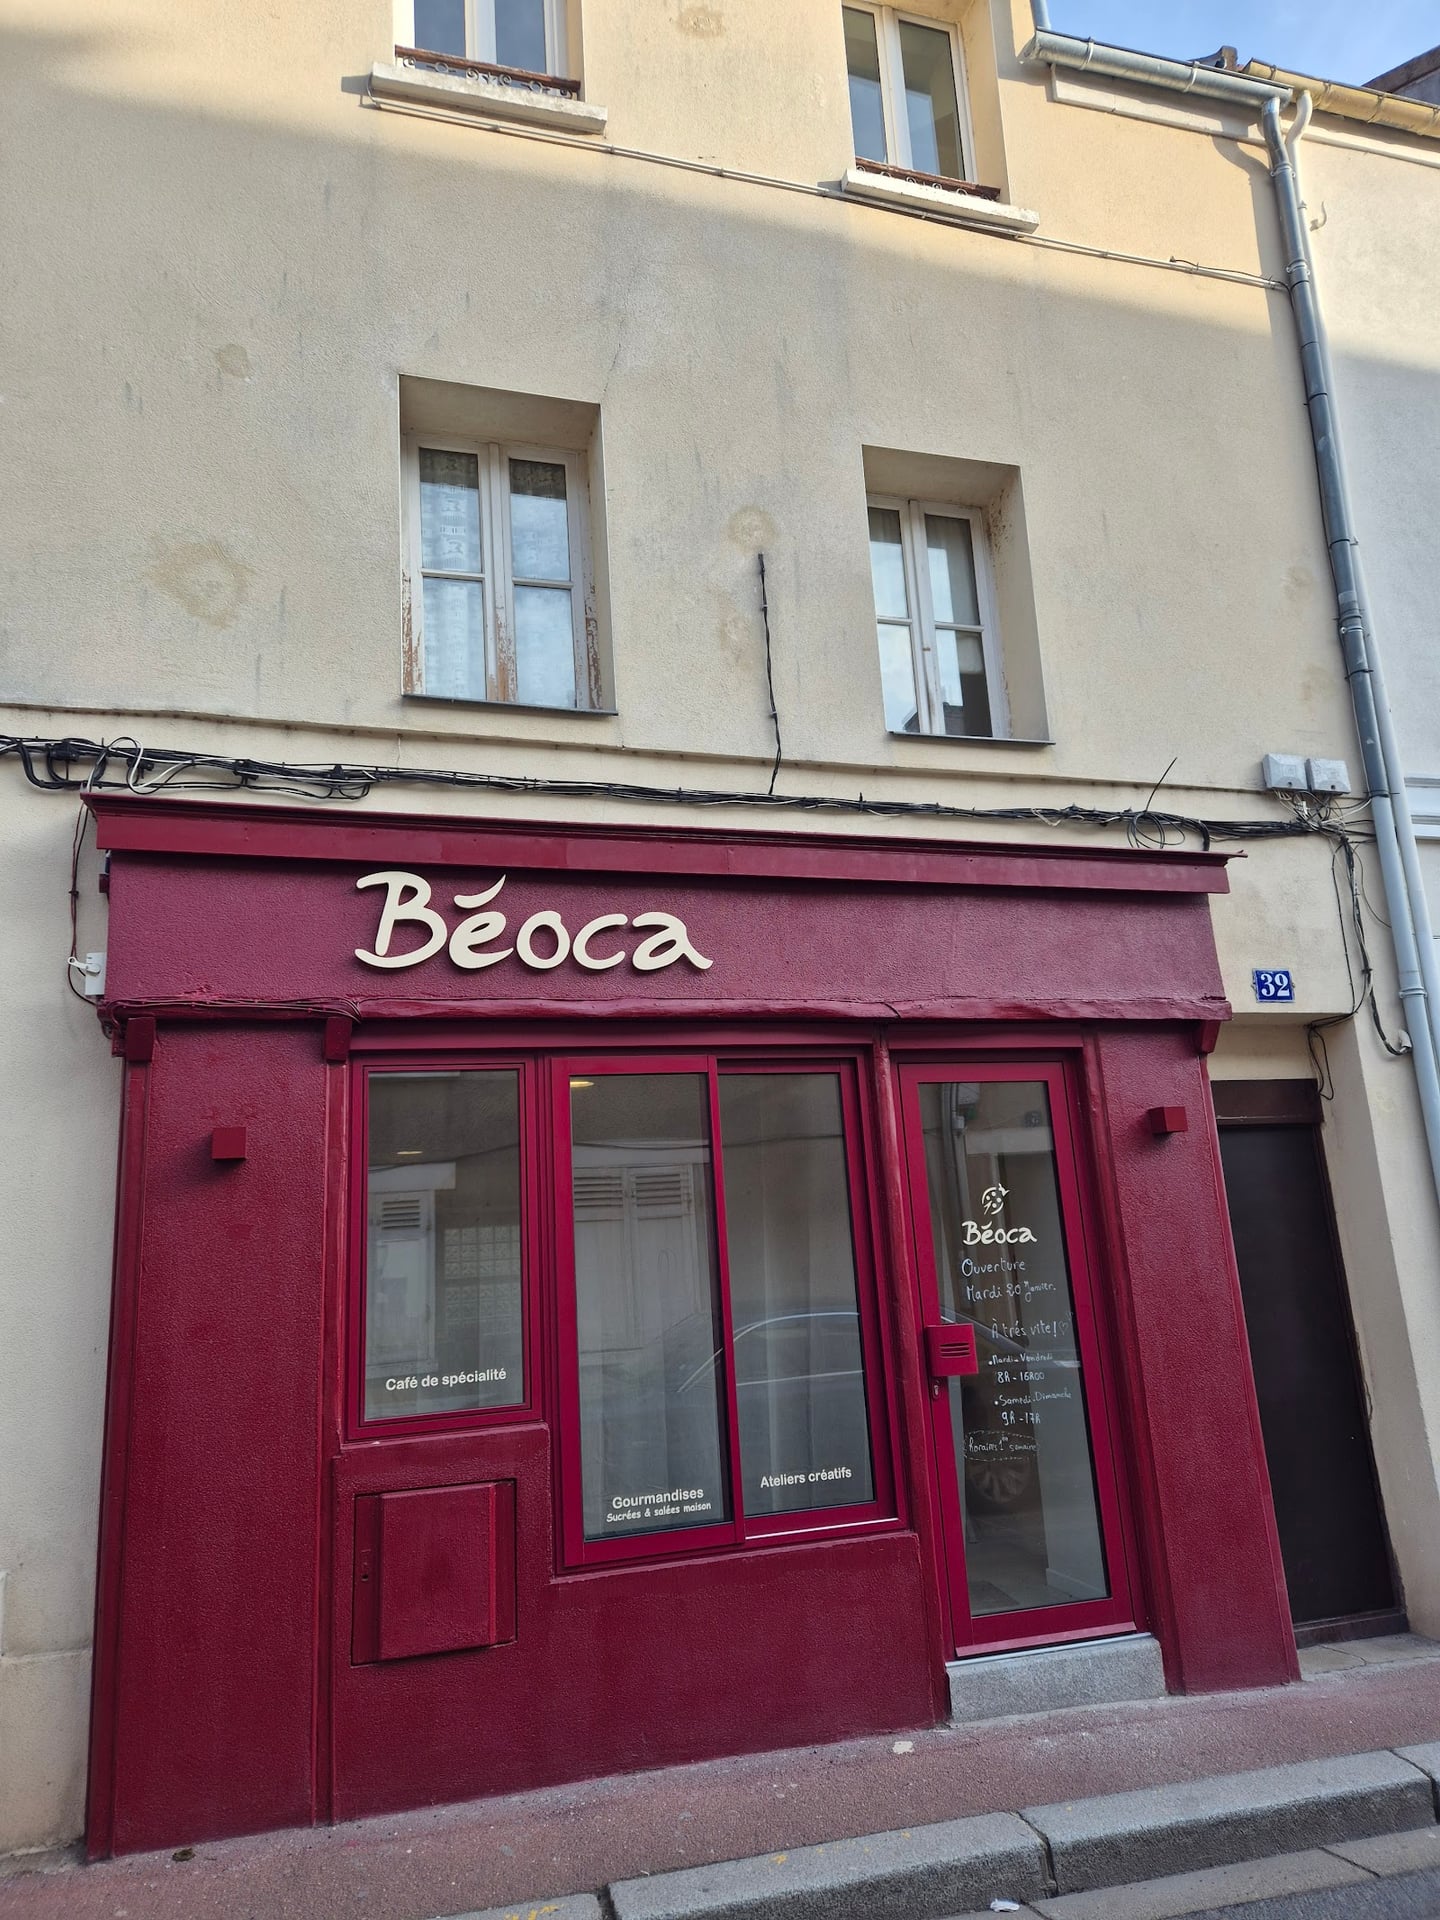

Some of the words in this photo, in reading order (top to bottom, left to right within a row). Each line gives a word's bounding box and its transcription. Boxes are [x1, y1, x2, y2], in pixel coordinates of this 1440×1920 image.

[354, 871, 714, 971] Béoca
[1260, 973, 1290, 997] 32
[961, 1220, 1038, 1246] Béoca
[961, 1257, 1026, 1277] Ouverture
[966, 1284, 1002, 1302] Mardi
[385, 1376, 418, 1391] Café
[421, 1374, 439, 1387] de
[441, 1367, 507, 1387] spécialité
[760, 1474, 806, 1489] Ateliers
[808, 1466, 852, 1482] créatifs
[612, 1488, 704, 1510] Gourmandises
[606, 1509, 642, 1523] Sucrées
[644, 1506, 651, 1518] &
[654, 1504, 681, 1517] salées
[683, 1501, 712, 1513] maison
